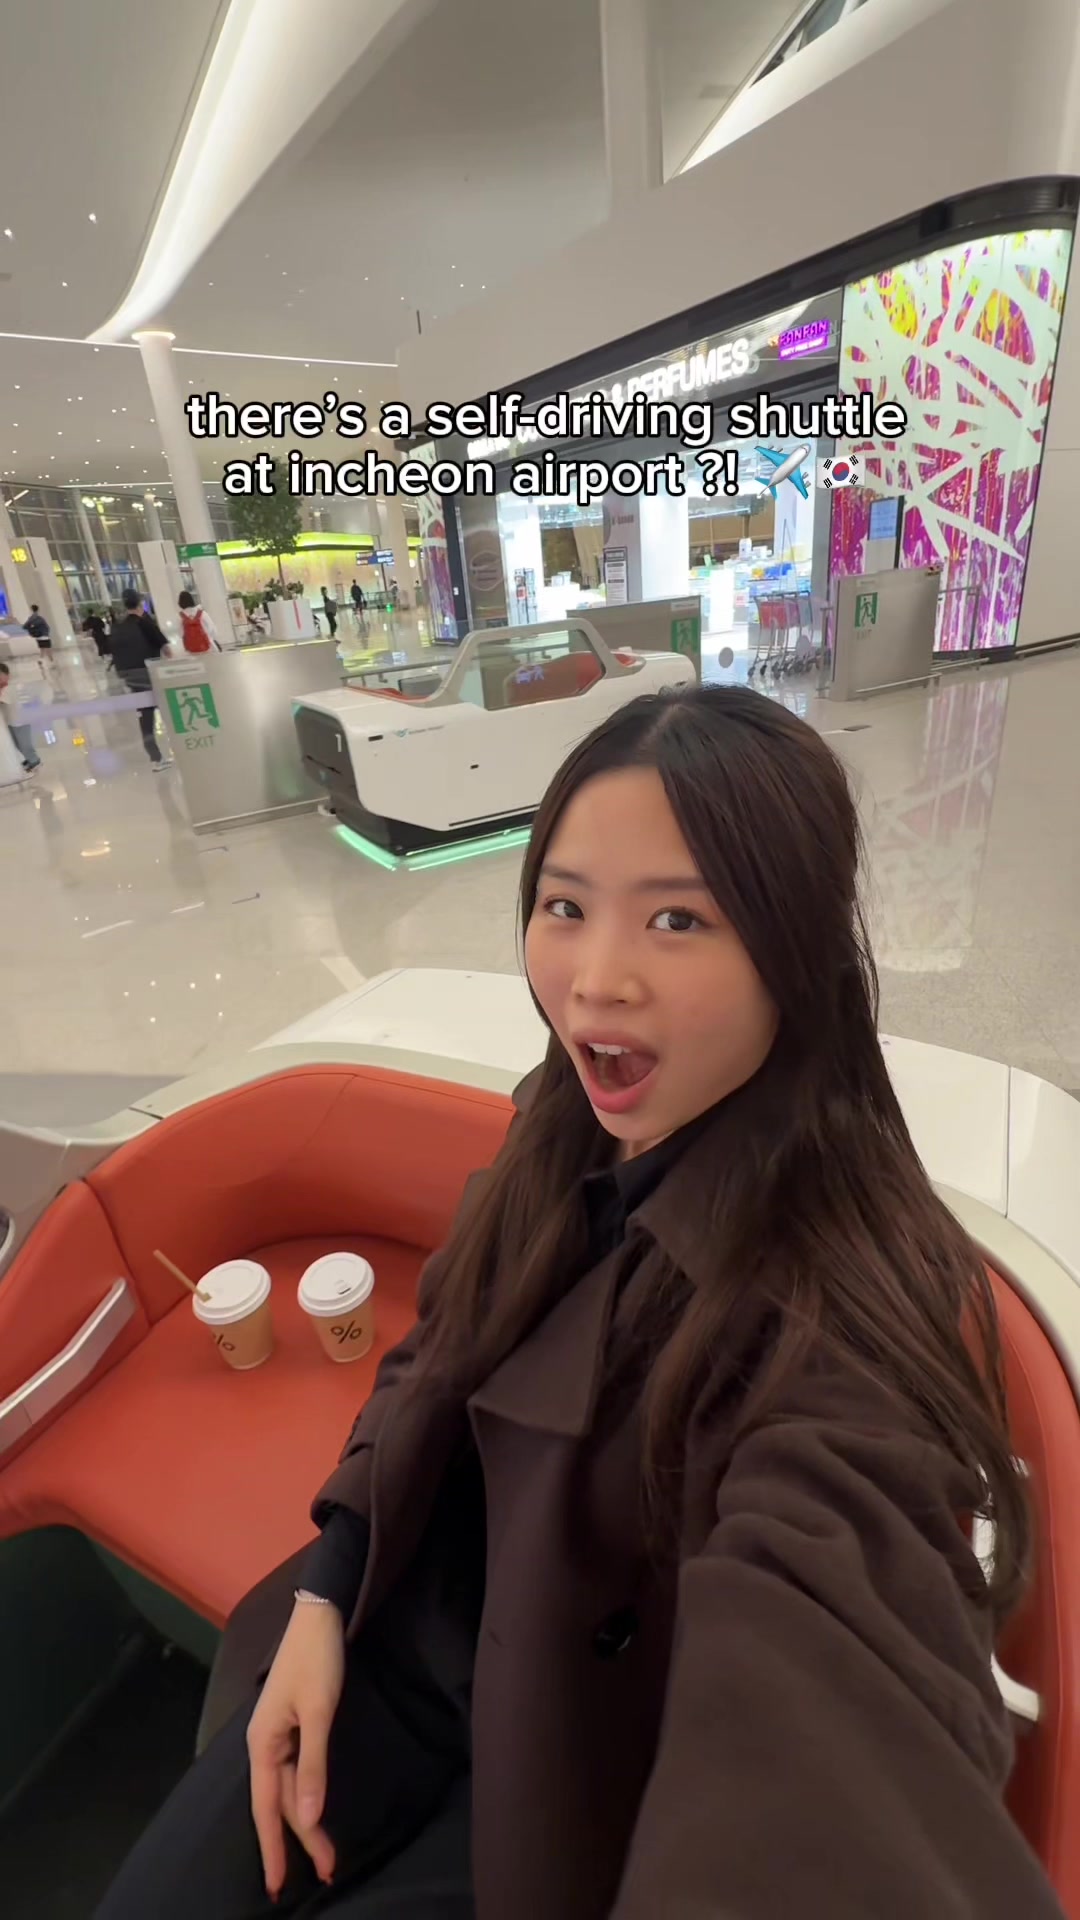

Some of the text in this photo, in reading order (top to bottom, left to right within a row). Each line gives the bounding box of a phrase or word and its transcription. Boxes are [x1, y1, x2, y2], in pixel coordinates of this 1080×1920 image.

[628, 337, 750, 404] PERFUMES
[184, 736, 215, 750] EXIT
[334, 732, 342, 753] 1
